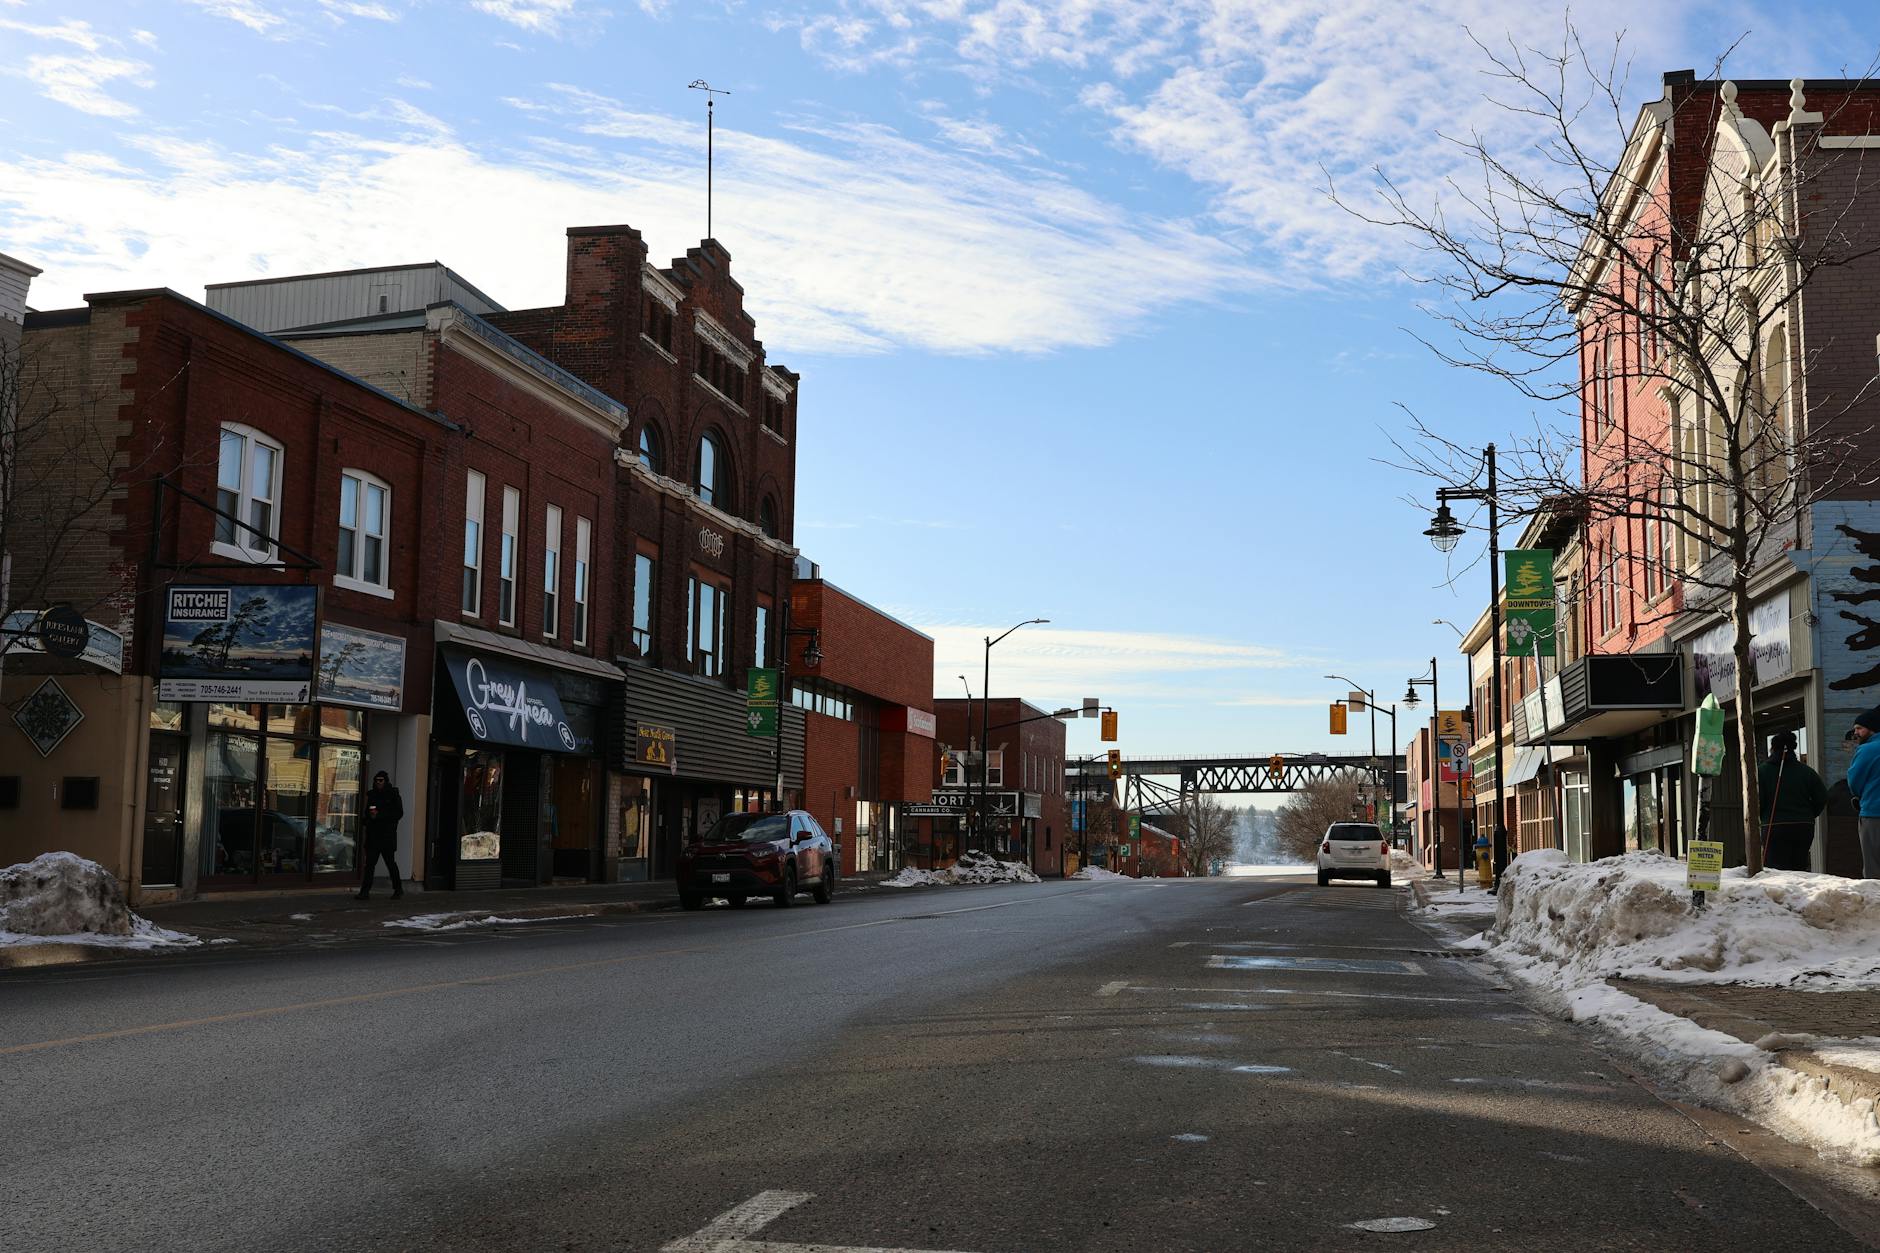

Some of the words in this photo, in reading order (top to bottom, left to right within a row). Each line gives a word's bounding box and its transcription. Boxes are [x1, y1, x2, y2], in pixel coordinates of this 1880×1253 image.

[173, 593, 227, 608] RITCHIE
[1507, 600, 1551, 608] DOWNTOWN
[172, 608, 226, 618] INSURANCE
[201, 685, 241, 694] 705-746-2441
[466, 658, 515, 710] Grey
[488, 681, 555, 742] Area
